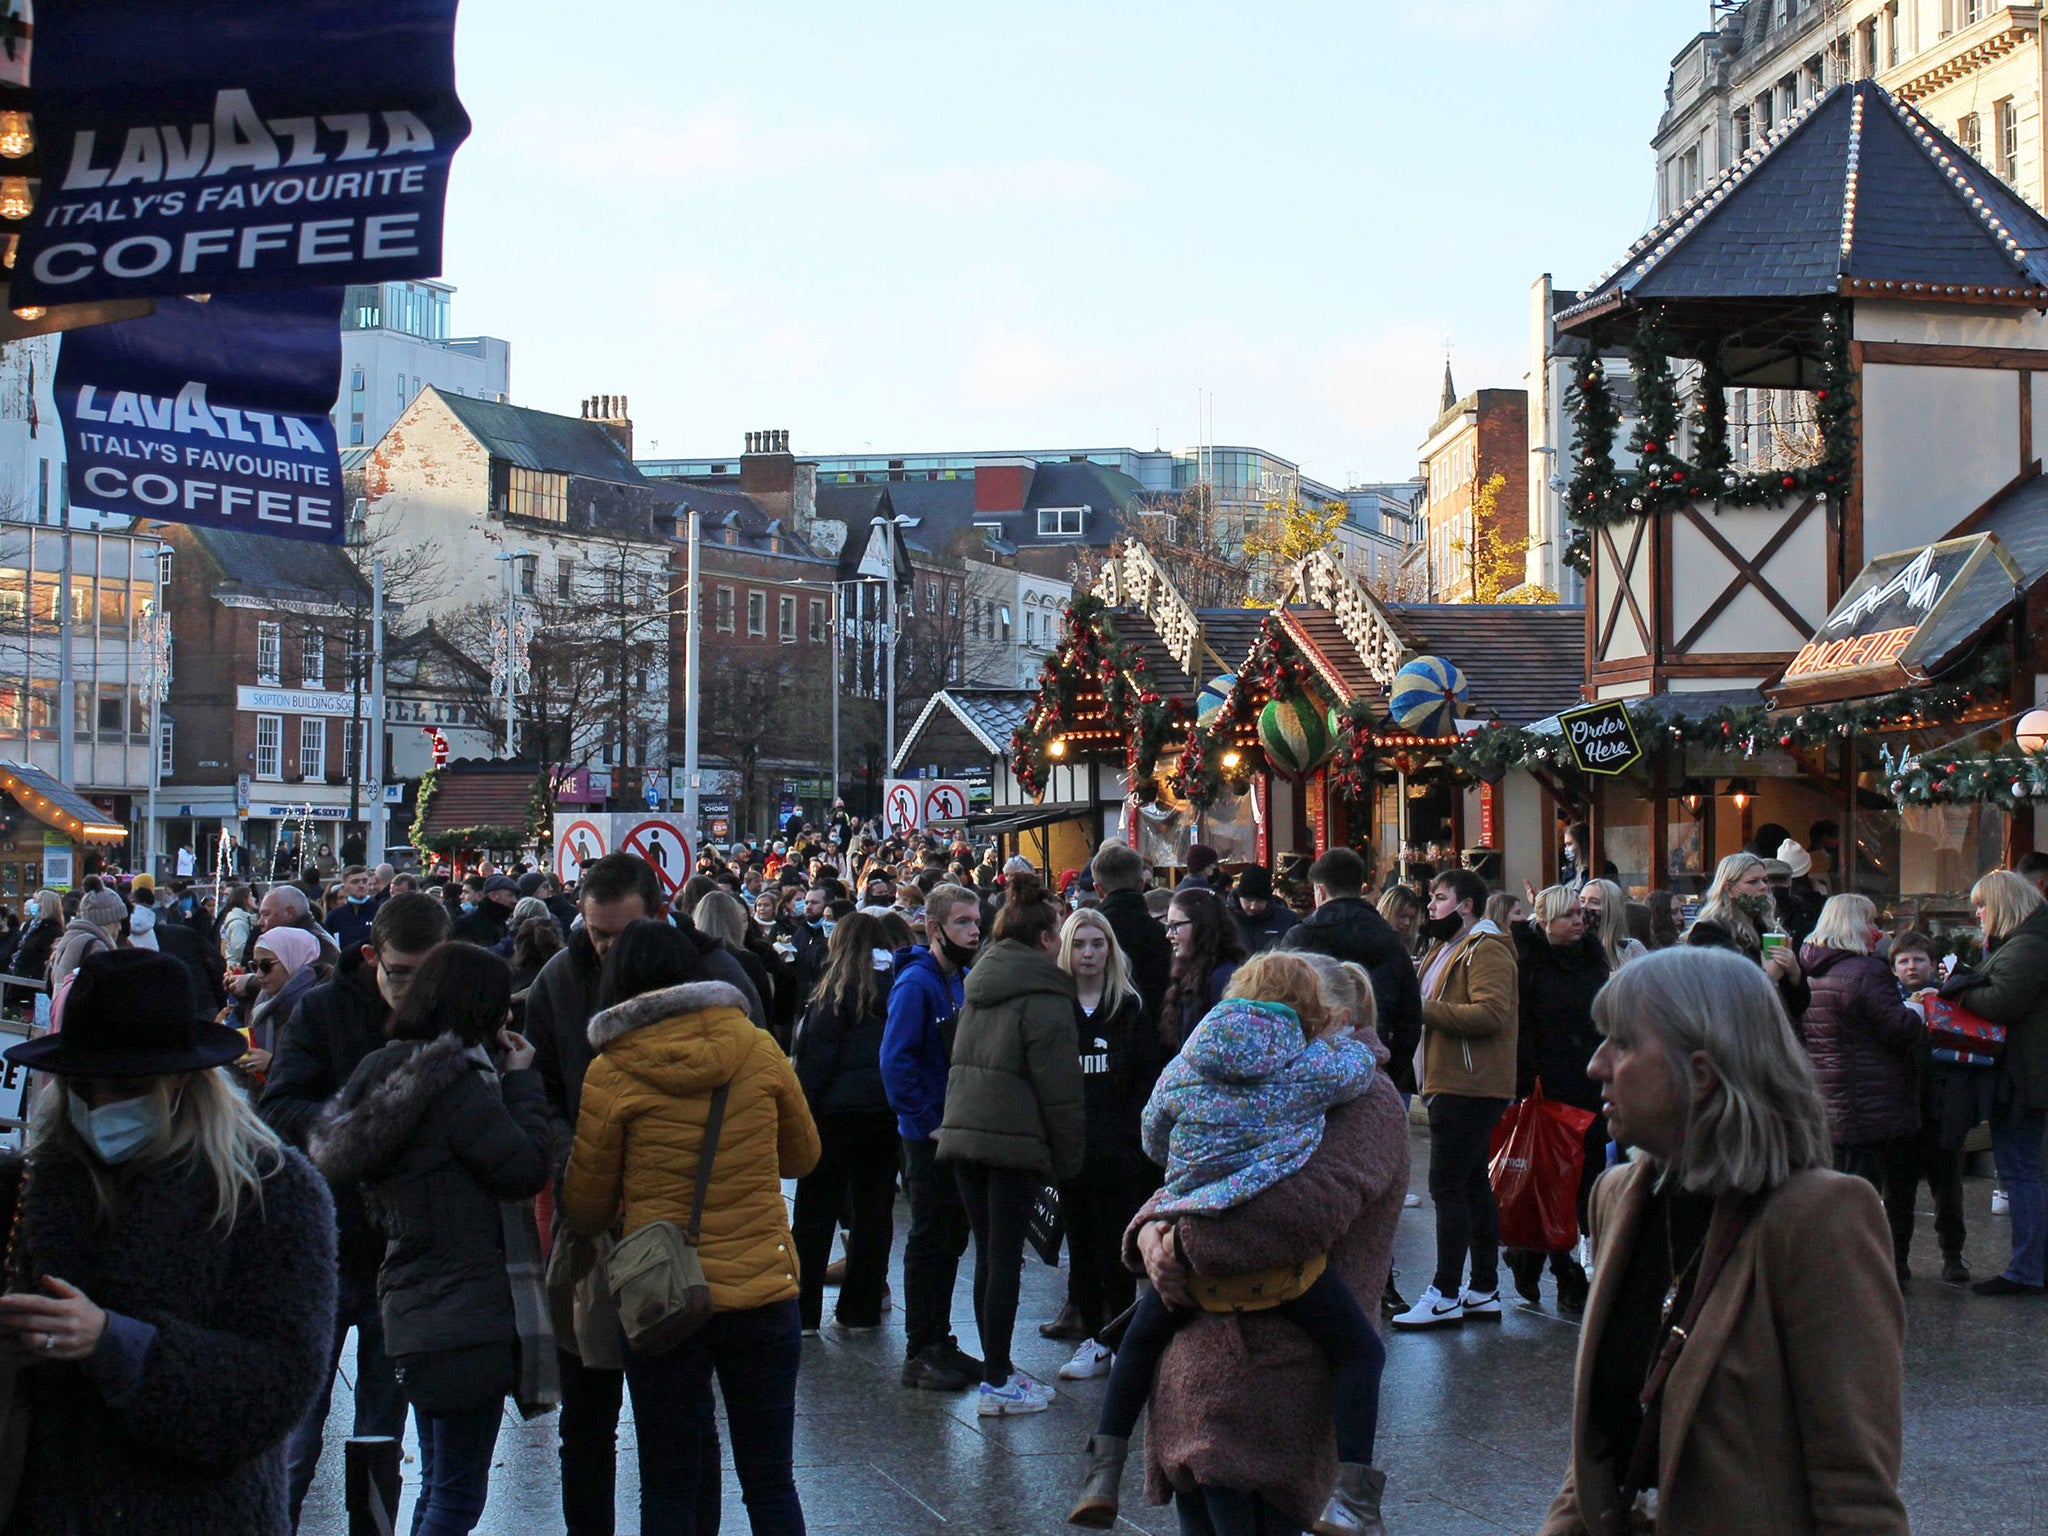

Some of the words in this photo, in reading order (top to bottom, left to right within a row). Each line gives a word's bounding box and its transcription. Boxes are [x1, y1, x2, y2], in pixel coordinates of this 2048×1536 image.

[61, 89, 436, 191] LAVAZZA
[45, 190, 185, 228] ITALY'S
[197, 165, 427, 213] FAVOURITE
[32, 213, 420, 285] COFFEE
[75, 381, 325, 454] LAVAZZA
[80, 432, 177, 466] ITALY'S
[186, 447, 330, 487] FAVOURITE
[84, 466, 333, 530] COFFEE
[1785, 625, 1920, 677] RACLETTE
[253, 692, 290, 706] SKIPTON
[292, 695, 334, 710] BUILDING
[337, 699, 371, 715] SOCTY
[1571, 716, 1626, 744] Order
[1585, 740, 1631, 763] Here
[368, 784, 378, 794] 25
